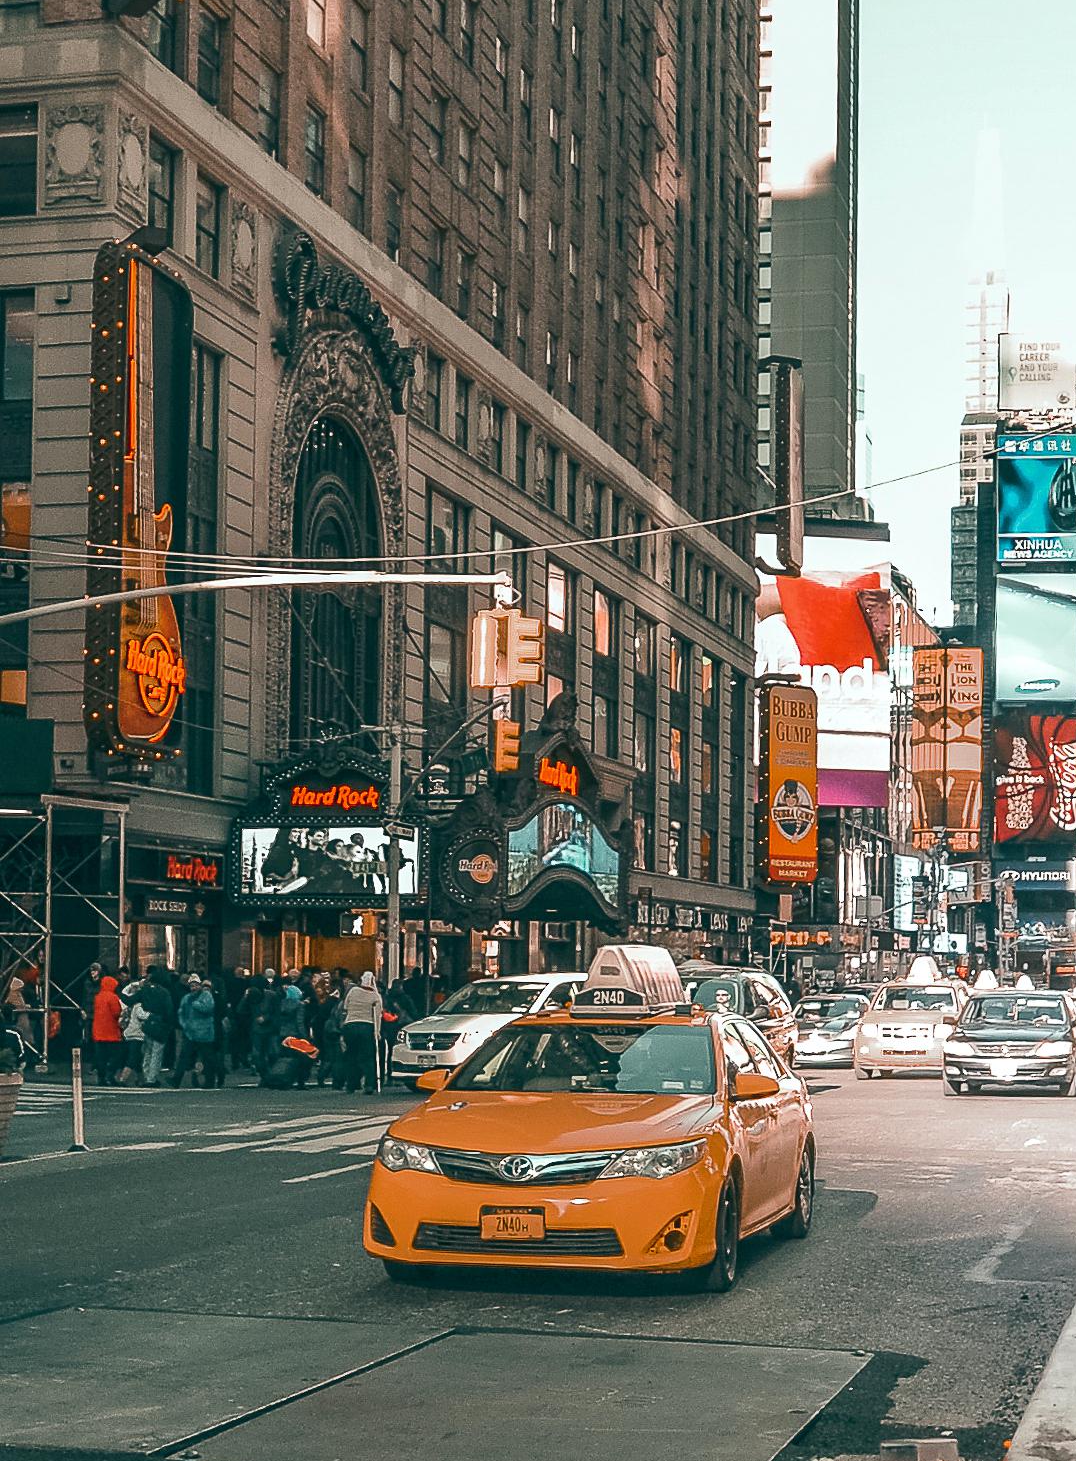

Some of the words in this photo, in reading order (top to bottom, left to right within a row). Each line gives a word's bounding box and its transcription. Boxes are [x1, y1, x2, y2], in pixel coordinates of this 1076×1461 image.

[1019, 342, 1038, 351] FIND
[1019, 363, 1035, 372] AND
[1013, 539, 1063, 551] XINHUA
[1003, 550, 1032, 559] NEWS
[1032, 550, 1074, 559] AGENCY
[127, 639, 158, 678] Hard
[157, 650, 185, 694] Rock
[954, 662, 974, 672] THE
[951, 673, 977, 686] LION
[950, 688, 980, 704] KING
[772, 695, 815, 719] BUBBA
[776, 721, 812, 743] GUMP
[291, 785, 337, 807] Hard
[336, 785, 380, 810] Rock
[459, 859, 483, 871] Hard
[770, 859, 816, 868] RESTAURANT
[166, 855, 193, 879] Hard
[193, 857, 217, 886] Rock
[778, 869, 808, 878] MARKET
[1020, 871, 1071, 881] HYUNDAI
[593, 990, 625, 1005] 2N40
